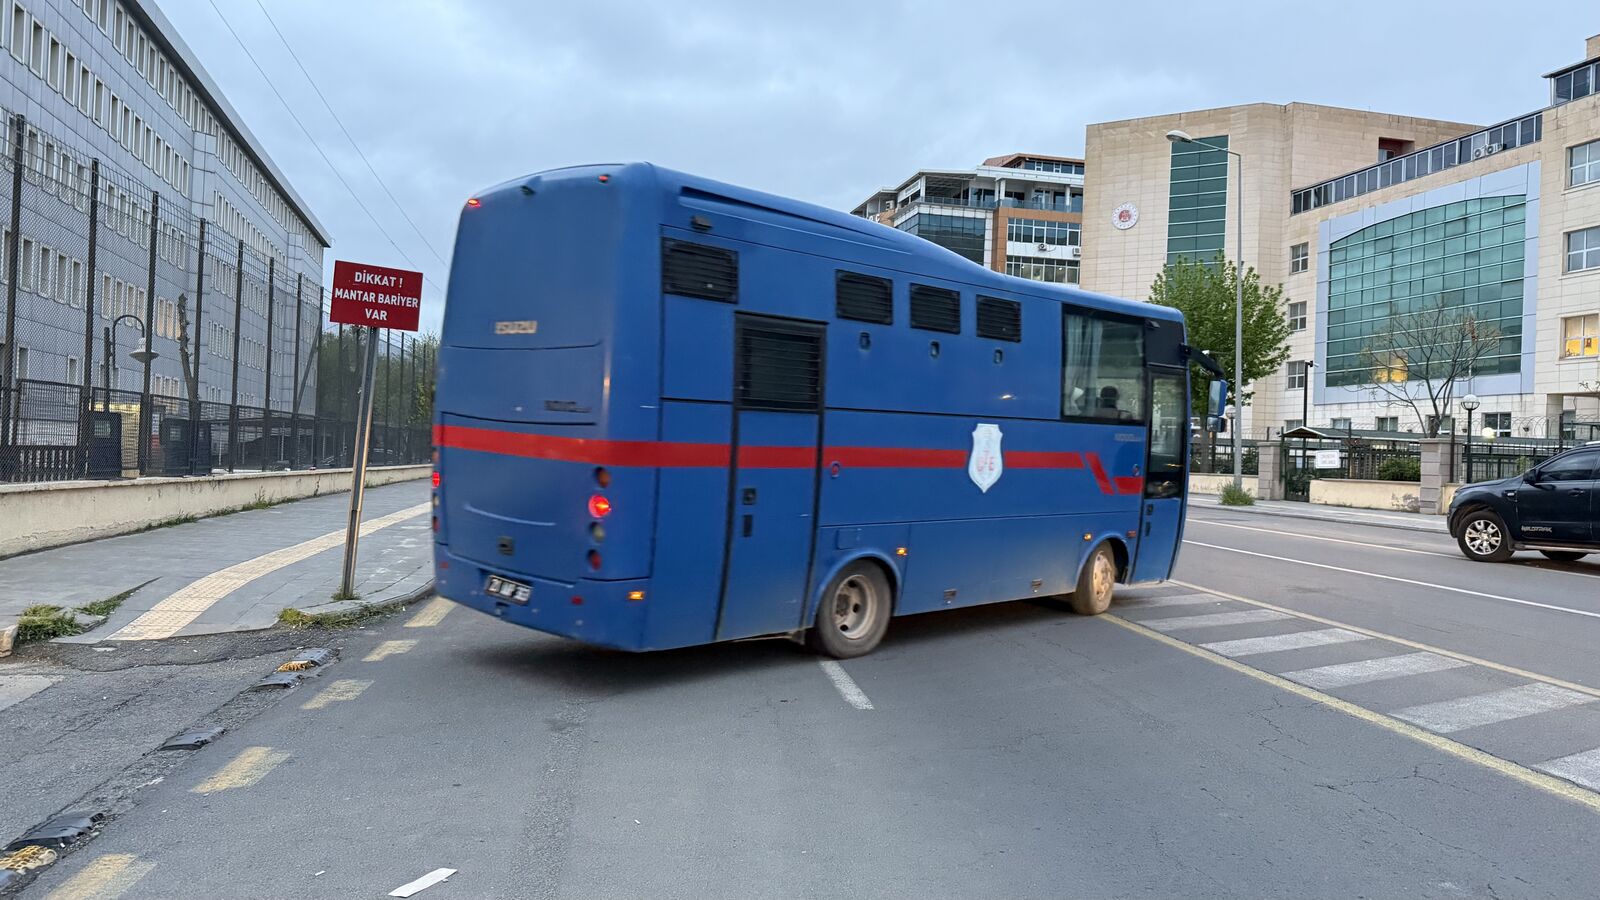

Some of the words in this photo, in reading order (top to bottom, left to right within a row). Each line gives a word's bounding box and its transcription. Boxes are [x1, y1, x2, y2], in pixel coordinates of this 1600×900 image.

[354, 269, 396, 287] DİKKAT
[335, 288, 376, 303] MANTAR
[378, 293, 418, 308] BARİYER
[365, 308, 387, 321] VAR
